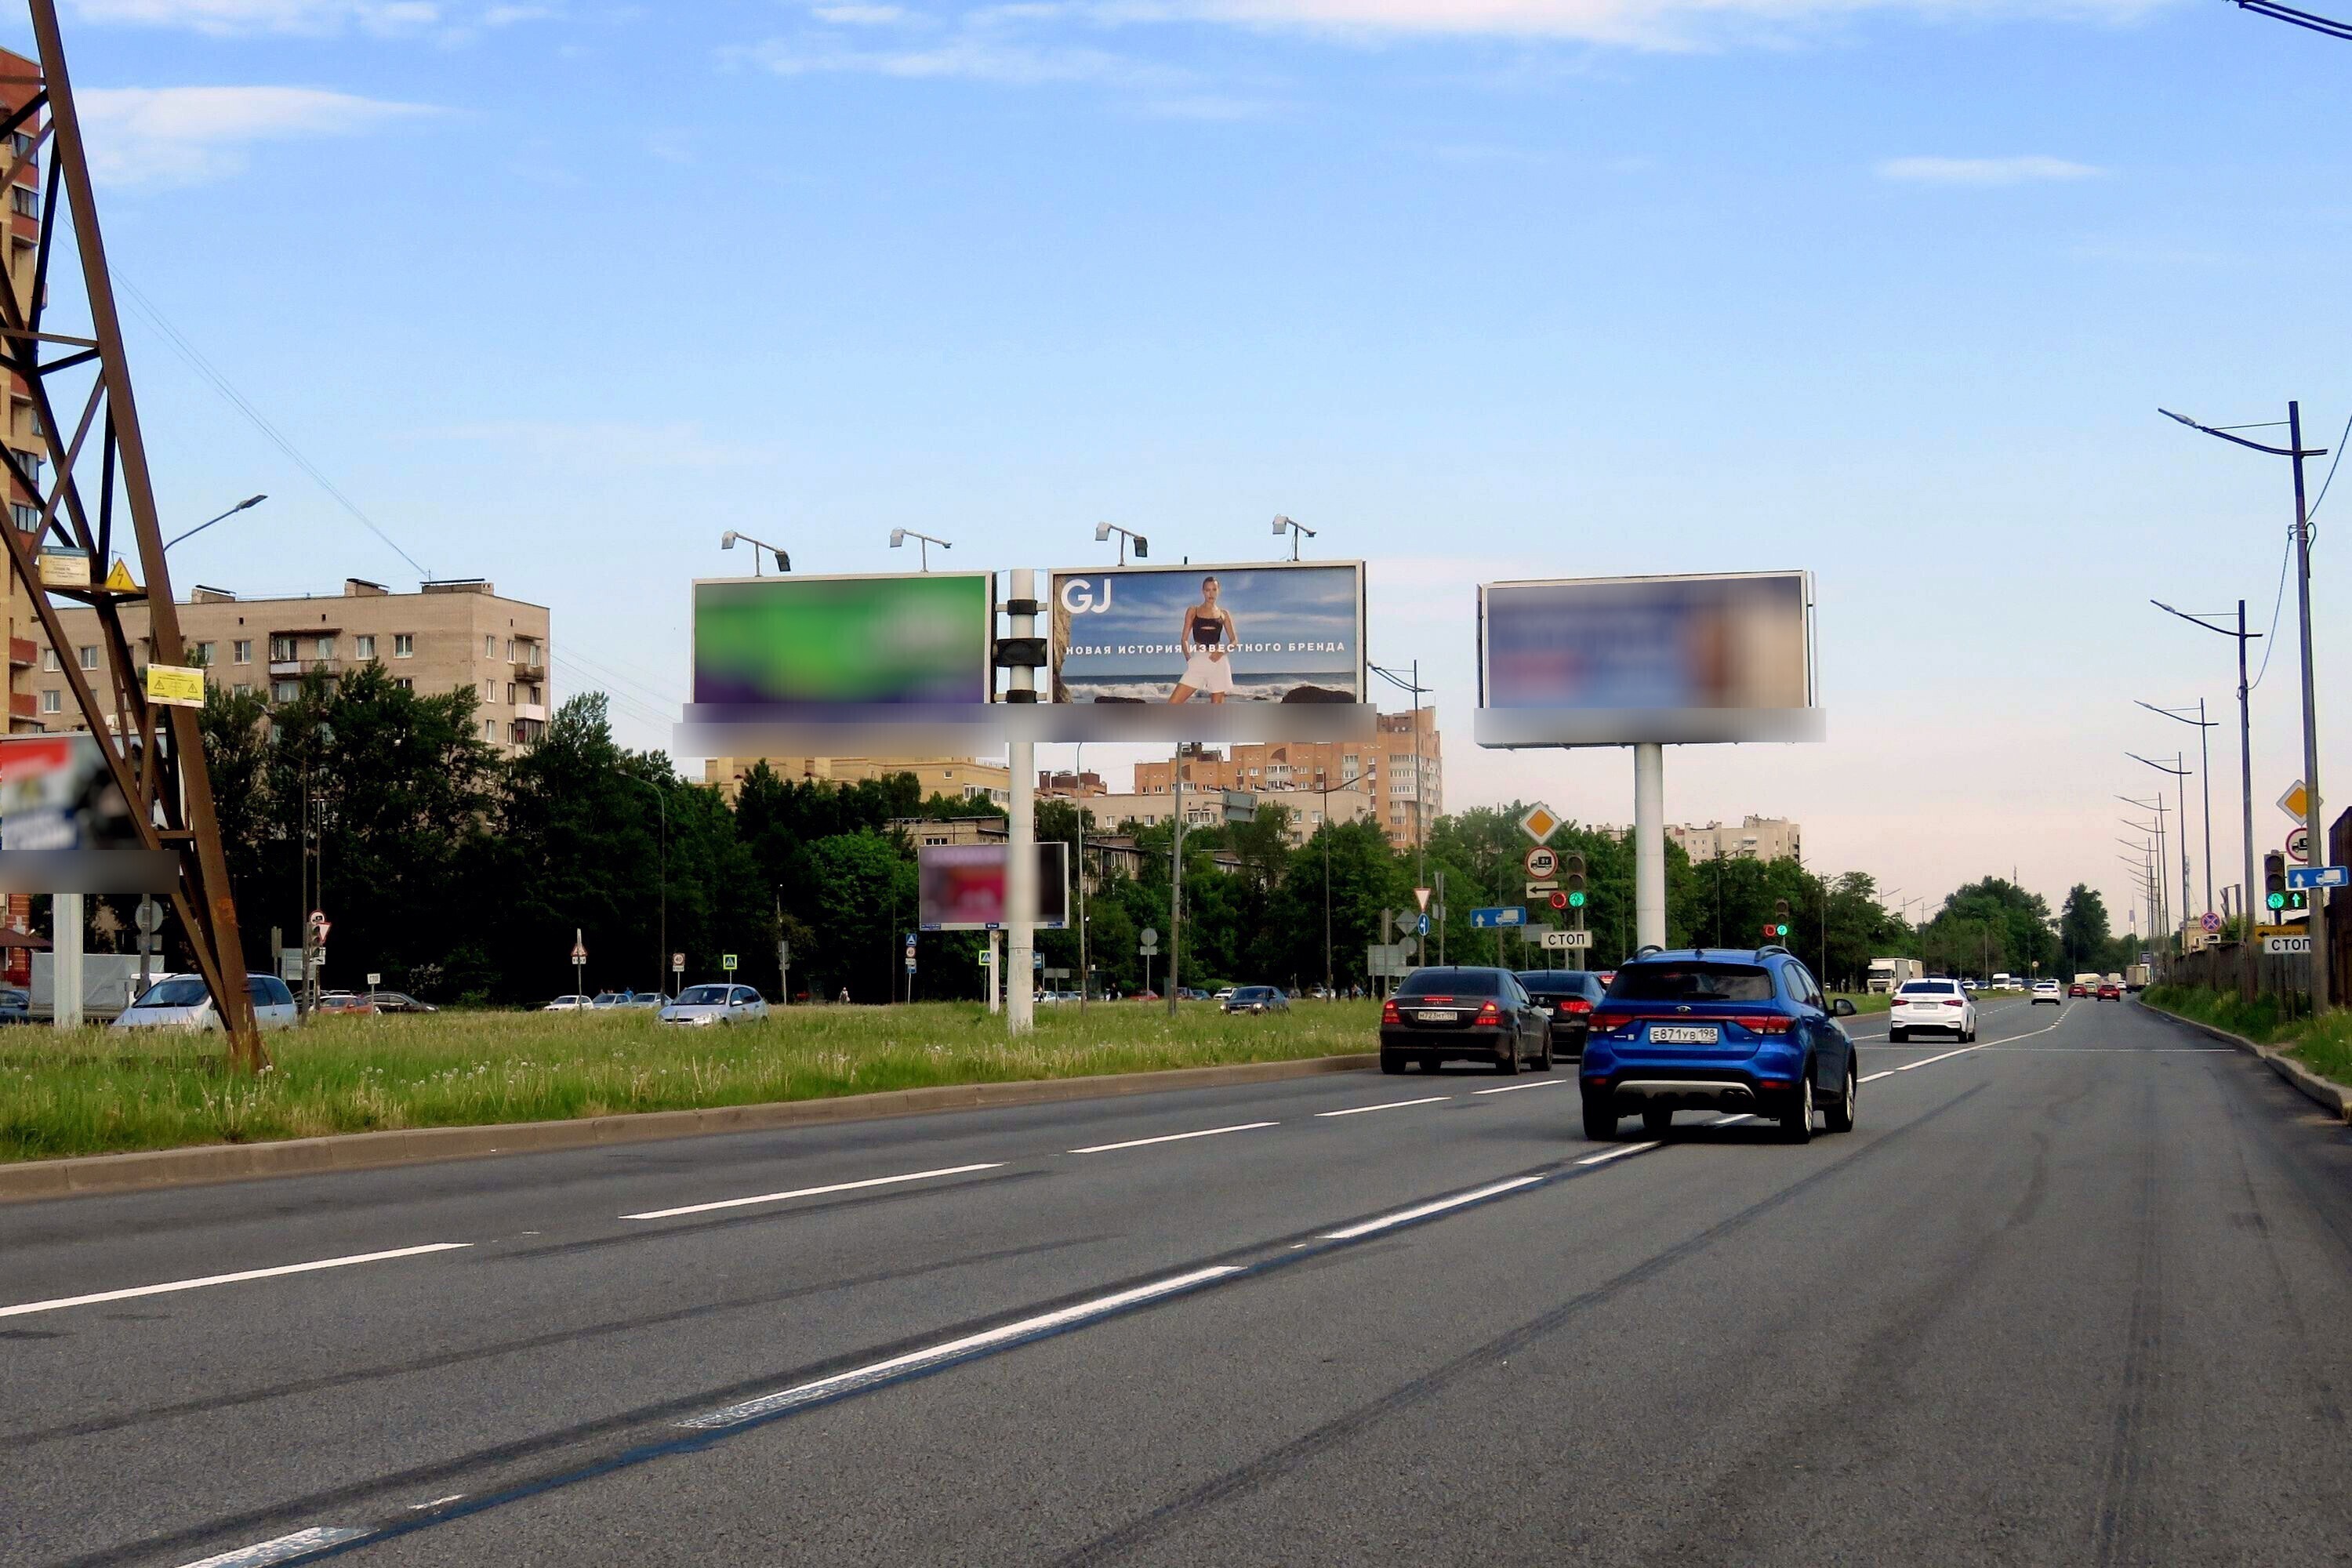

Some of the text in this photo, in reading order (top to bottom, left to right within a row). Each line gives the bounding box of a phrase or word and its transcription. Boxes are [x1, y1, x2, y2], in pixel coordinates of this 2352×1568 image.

[1061, 579, 1112, 614] GJ
[1066, 642, 1345, 655] НОВАЯ ИСТОРИЯ ИЗВЕСТНОГО БРЕНДА
[1548, 934, 1584, 946] СТОП
[2271, 938, 2310, 951] СТОП
[1653, 1029, 1715, 1040] Е871УВ 198
